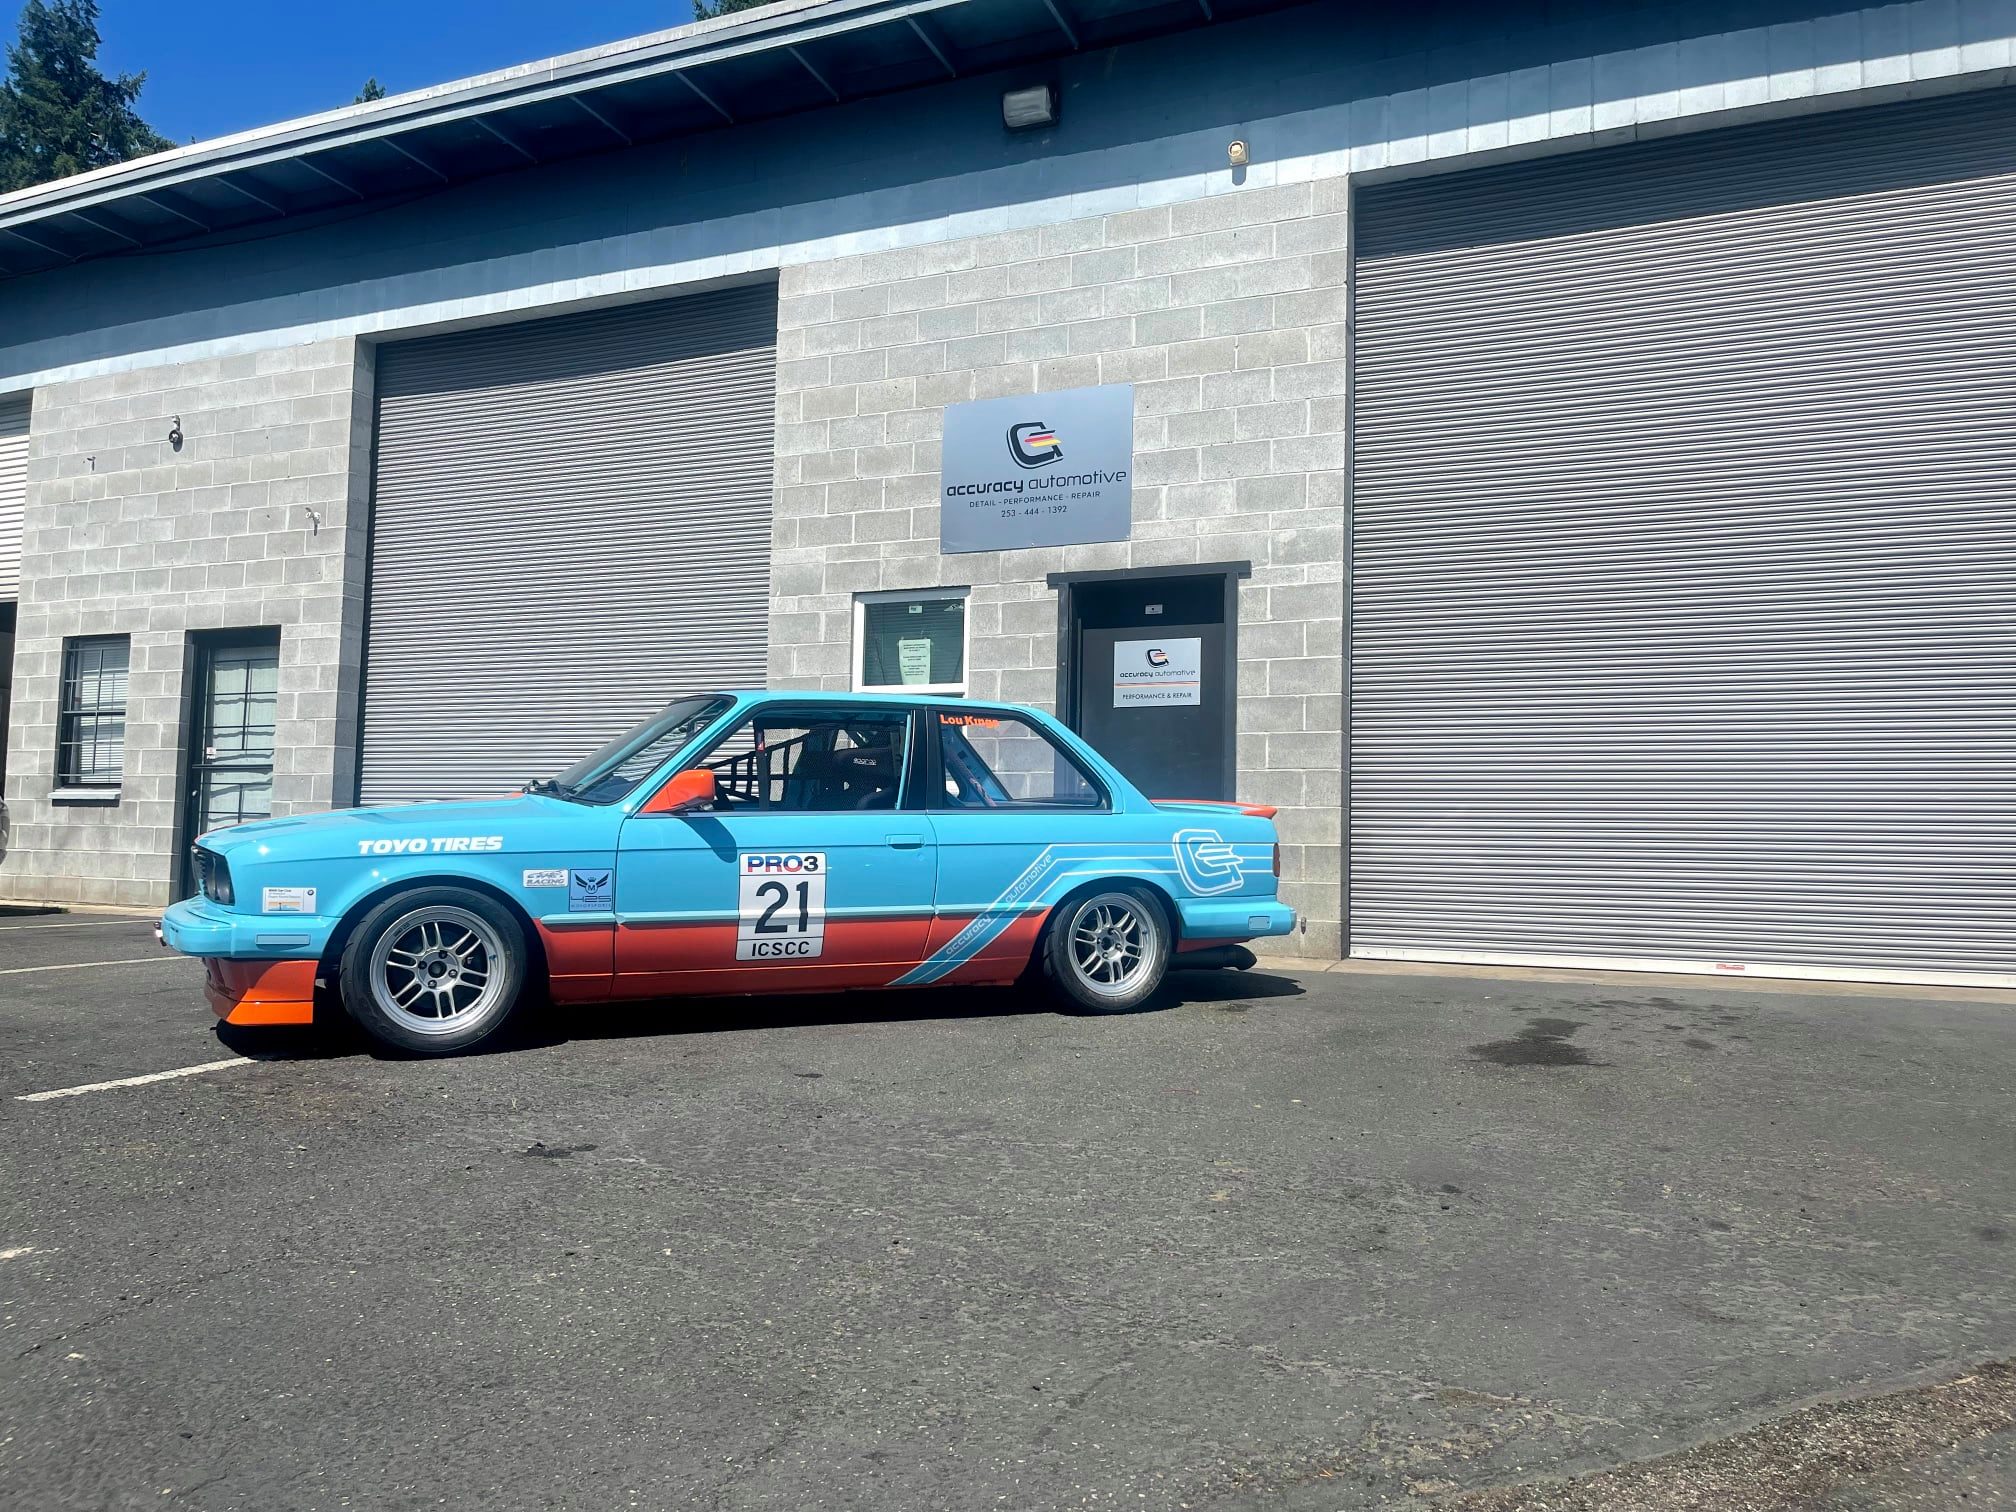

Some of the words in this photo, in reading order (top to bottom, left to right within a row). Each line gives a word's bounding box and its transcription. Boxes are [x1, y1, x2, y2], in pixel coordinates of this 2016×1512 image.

[946, 479, 1024, 497] accuracy
[1028, 469, 1127, 490] automotive
[969, 500, 996, 508] DETAIL
[1003, 494, 1064, 505] PERFORMANCE
[1071, 490, 1101, 499] REPAIR
[1001, 509, 1016, 518] 253
[1024, 507, 1039, 516] 444
[1048, 505, 1068, 514] 1392
[1154, 669, 1196, 677] automotive
[1122, 692, 1166, 700] PERFORMANCE
[939, 713, 963, 725] Lou
[357, 837, 428, 855] TOYO
[430, 836, 504, 852] TIRES
[747, 855, 819, 873] PRO3
[754, 880, 809, 934] 21
[946, 913, 992, 956] accuracy
[1004, 854, 1052, 904] automotive
[751, 941, 810, 957] ICSCC
